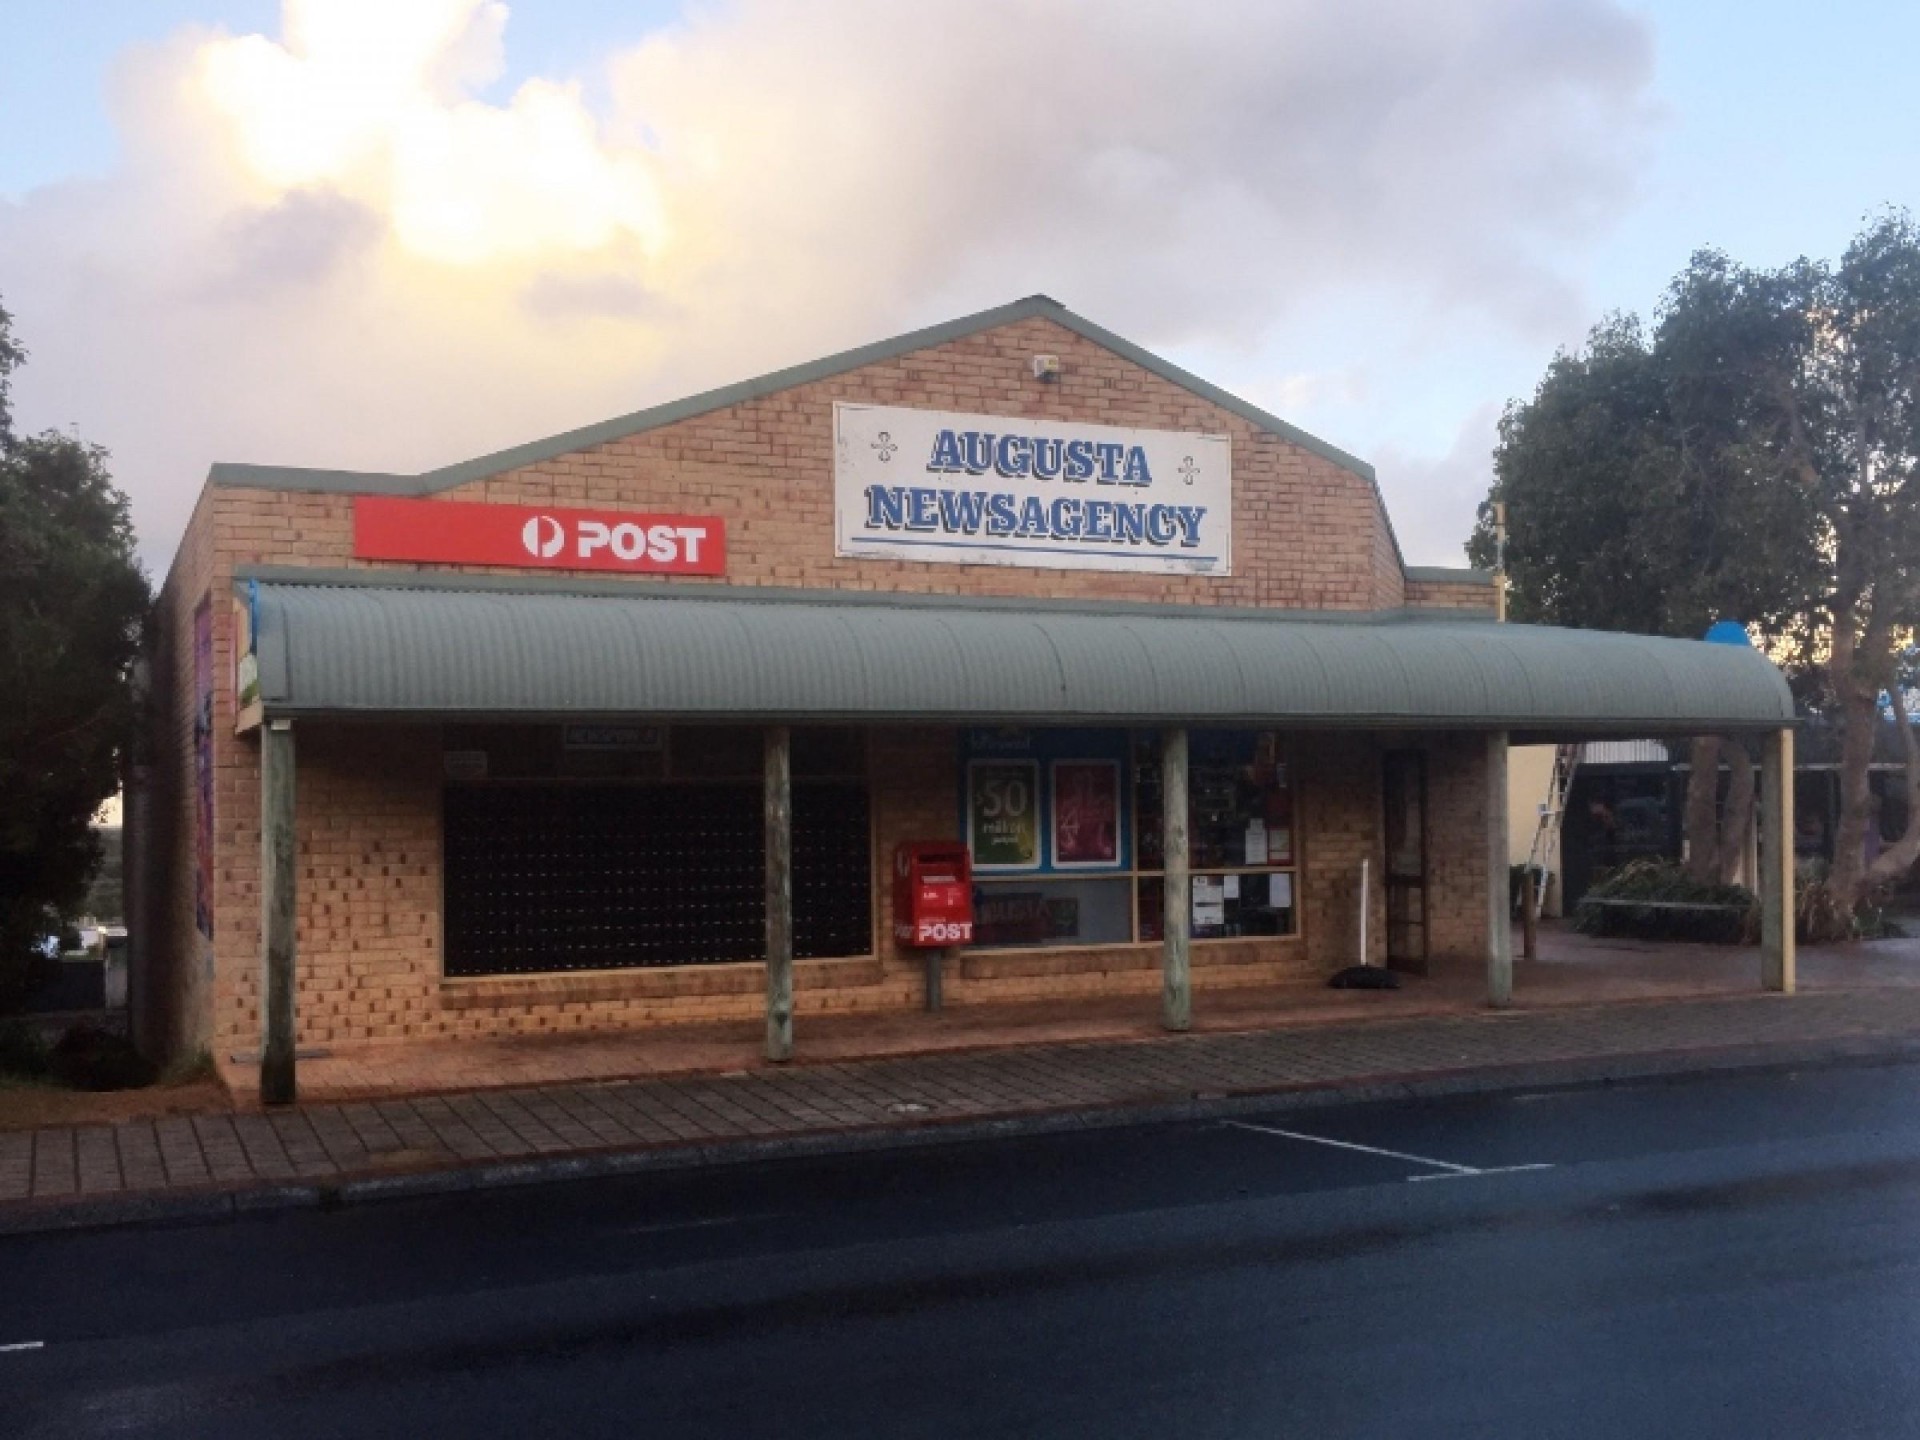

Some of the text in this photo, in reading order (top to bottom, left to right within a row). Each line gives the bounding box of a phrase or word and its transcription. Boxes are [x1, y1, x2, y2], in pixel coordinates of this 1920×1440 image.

[926, 429, 1152, 487] AUGUSTA
[864, 484, 1207, 547] NEWSAGENCY
[577, 520, 707, 563] POST
[918, 921, 973, 941] POST
